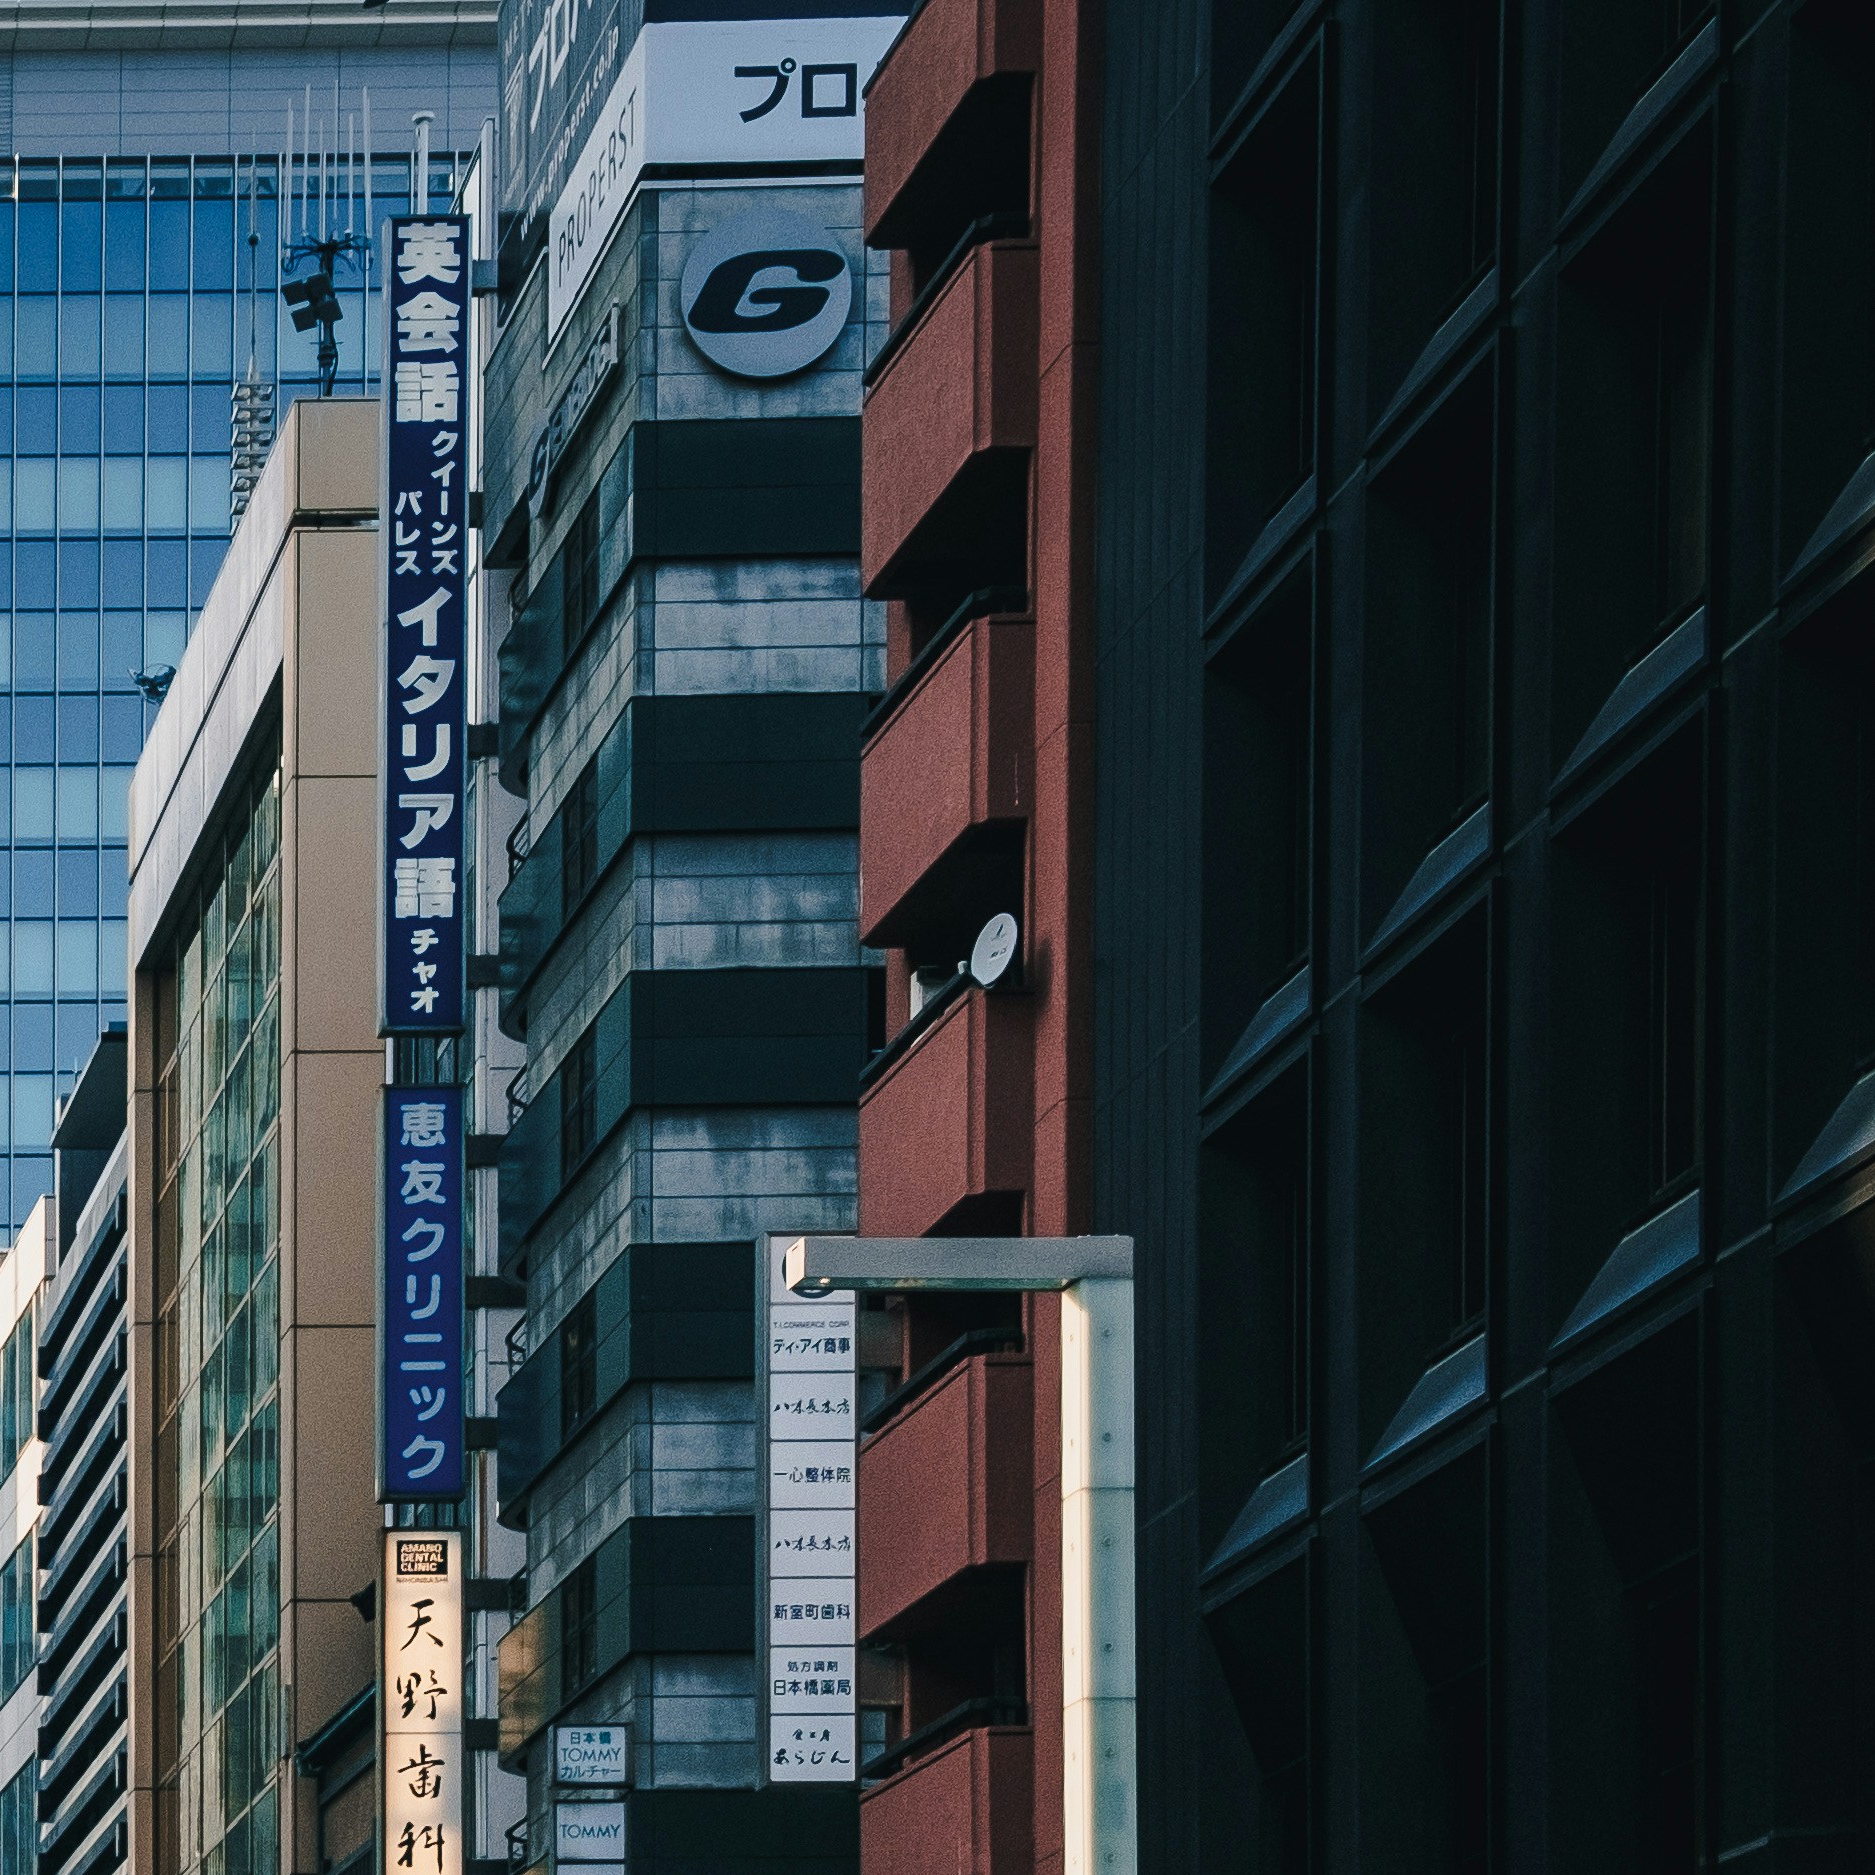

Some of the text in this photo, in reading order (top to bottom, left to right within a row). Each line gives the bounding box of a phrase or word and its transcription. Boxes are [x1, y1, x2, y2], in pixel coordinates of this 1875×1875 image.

[559, 86, 637, 288] PROPERST
[396, 222, 461, 425] 英会話
[430, 430, 458, 576] クイーンズ
[395, 491, 421, 576] パレス
[394, 588, 457, 919] イタリア語
[411, 928, 441, 1013] チャオ
[400, 1103, 450, 1480] 恵友クリニック
[773, 1337, 851, 1355] ティ・アイ商事
[773, 1466, 851, 1484] 一心整体院
[773, 1603, 851, 1621] 新室町歯科
[773, 1678, 851, 1696] 日本橋薬局
[787, 1661, 839, 1673] 処方調剤
[397, 1599, 449, 1875] 天野歯科
[560, 1747, 622, 1762] TOMMY
[560, 1765, 621, 1779] カルチャー
[560, 1824, 621, 1839] TOMMY
